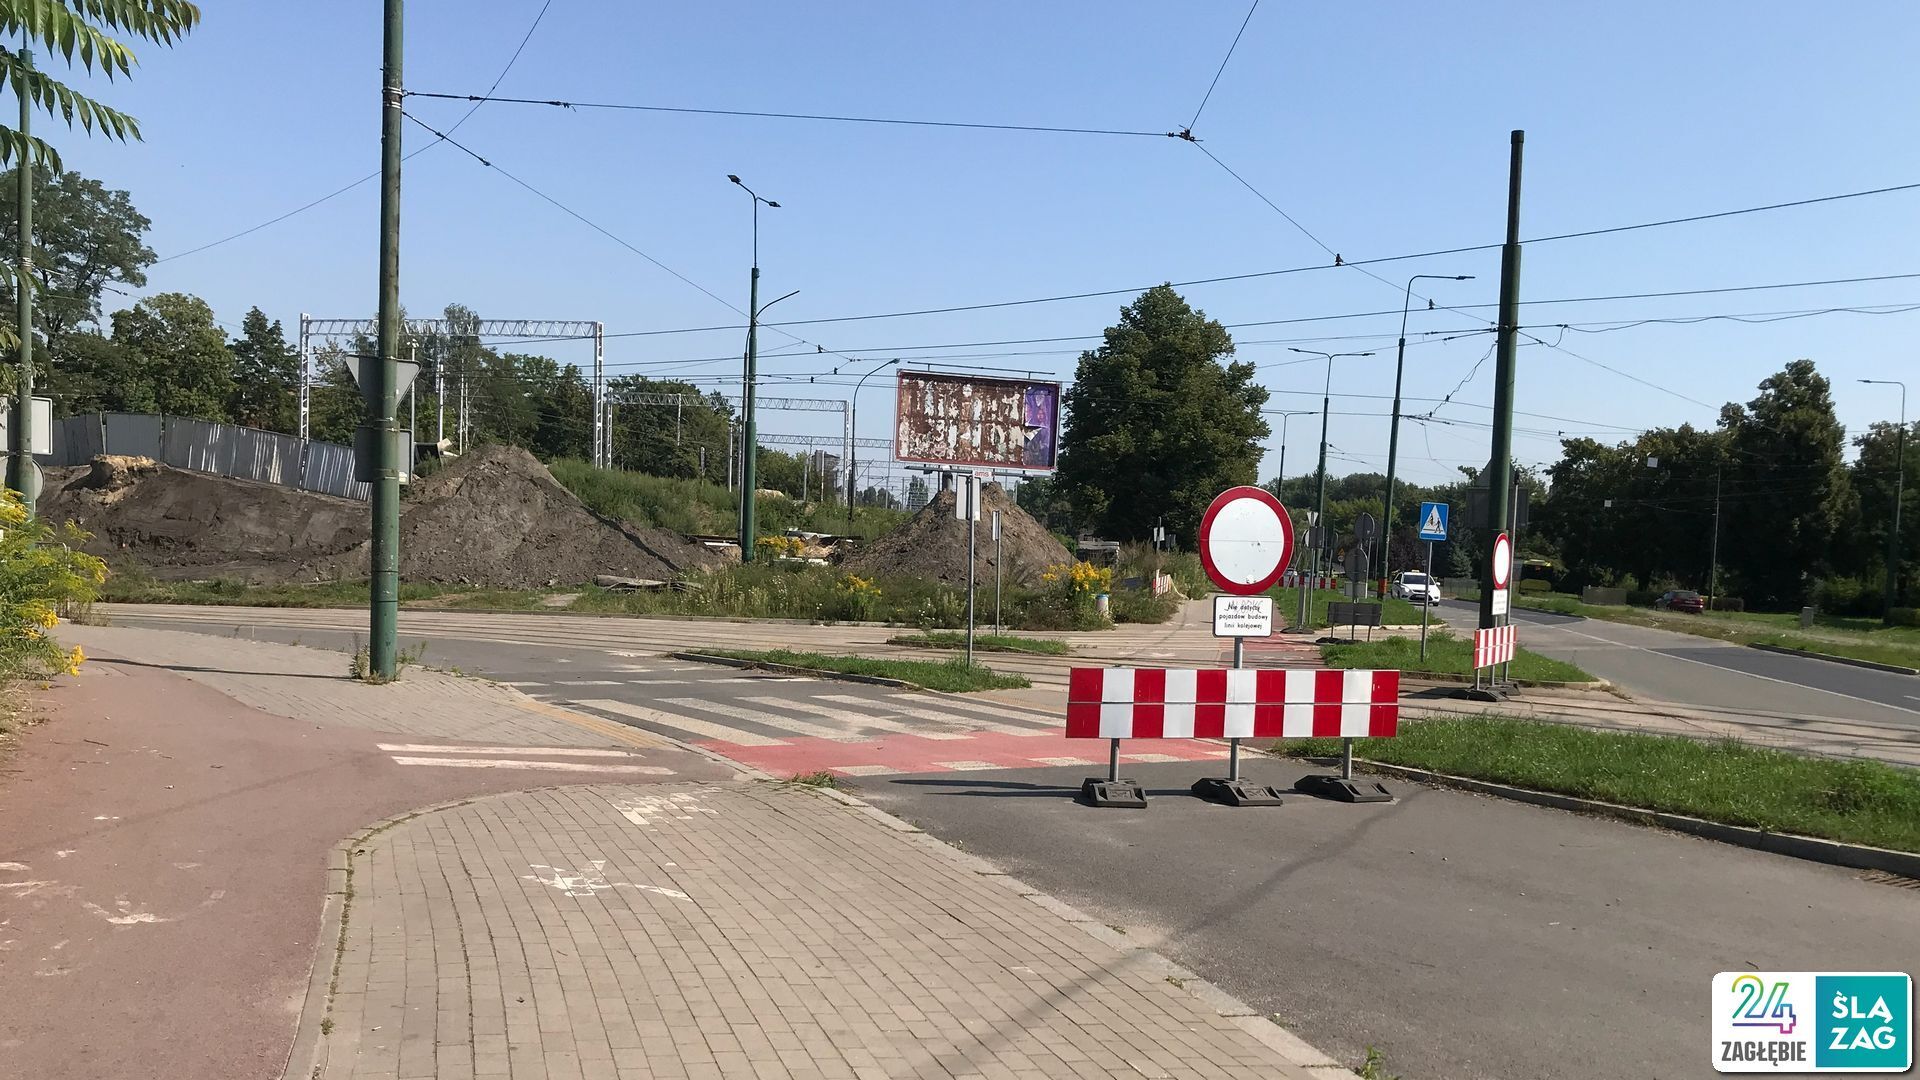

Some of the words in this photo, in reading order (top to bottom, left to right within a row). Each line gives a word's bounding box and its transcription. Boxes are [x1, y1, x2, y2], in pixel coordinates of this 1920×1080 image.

[1224, 600, 1238, 611] Nie
[1240, 604, 1262, 613] dotyczy
[1247, 613, 1268, 621] budowy
